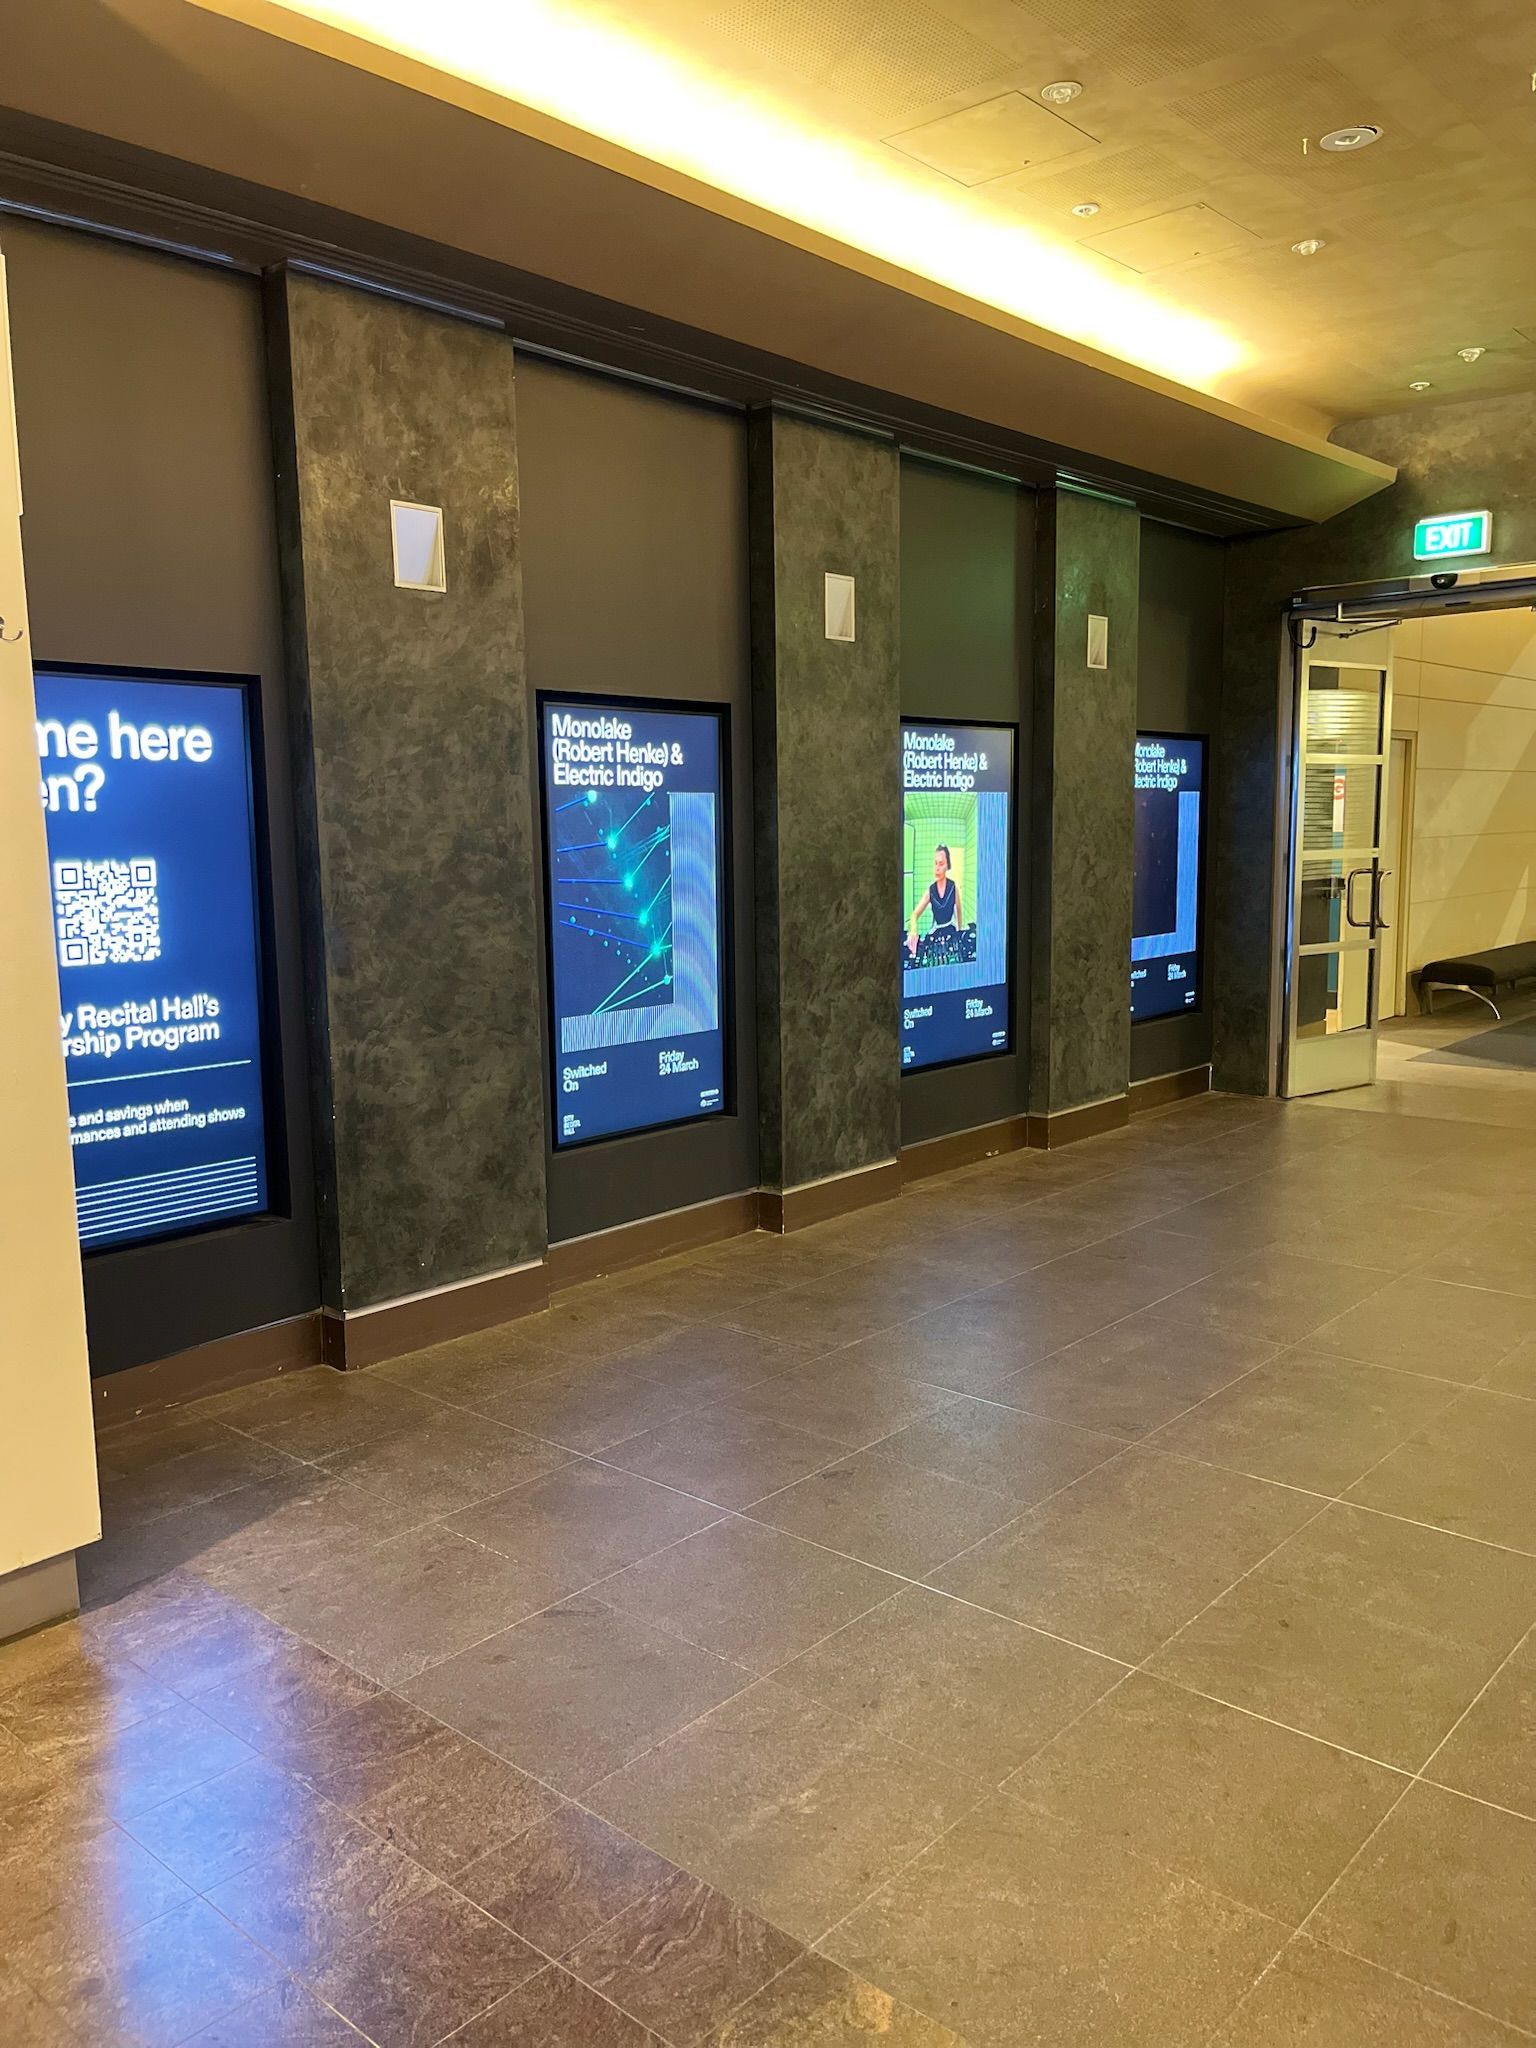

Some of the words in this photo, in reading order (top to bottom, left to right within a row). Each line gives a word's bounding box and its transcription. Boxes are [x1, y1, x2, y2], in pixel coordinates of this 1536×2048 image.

[1424, 521, 1473, 552] EXIT
[108, 710, 213, 763] here
[552, 713, 632, 740] Monolake
[552, 738, 614, 764] (Robert
[616, 741, 669, 767] Henke)
[670, 743, 684, 766] &
[903, 731, 955, 752] Monolake
[903, 751, 943, 771] (Robert
[943, 752, 978, 772] Henke)
[979, 753, 988, 770] &
[1180, 759, 1187, 774] &
[553, 763, 614, 786] Electric
[616, 764, 664, 792] Indigo
[903, 770, 943, 788] Electric
[943, 770, 975, 792] Indigo
[77, 999, 157, 1031] Recital
[162, 993, 220, 1022] Hall's
[125, 1021, 220, 1051] Program
[903, 1019, 914, 1030] On
[659, 1050, 685, 1065] Friday
[659, 1063, 672, 1076] 24
[672, 1058, 699, 1074] March
[563, 1061, 608, 1081] Switched
[563, 1080, 579, 1093] On
[78, 1109, 104, 1127] and
[105, 1104, 153, 1122] savings
[154, 1098, 189, 1116] when
[122, 1119, 147, 1137] and
[149, 1112, 206, 1133] attending
[207, 1106, 246, 1124] shows
